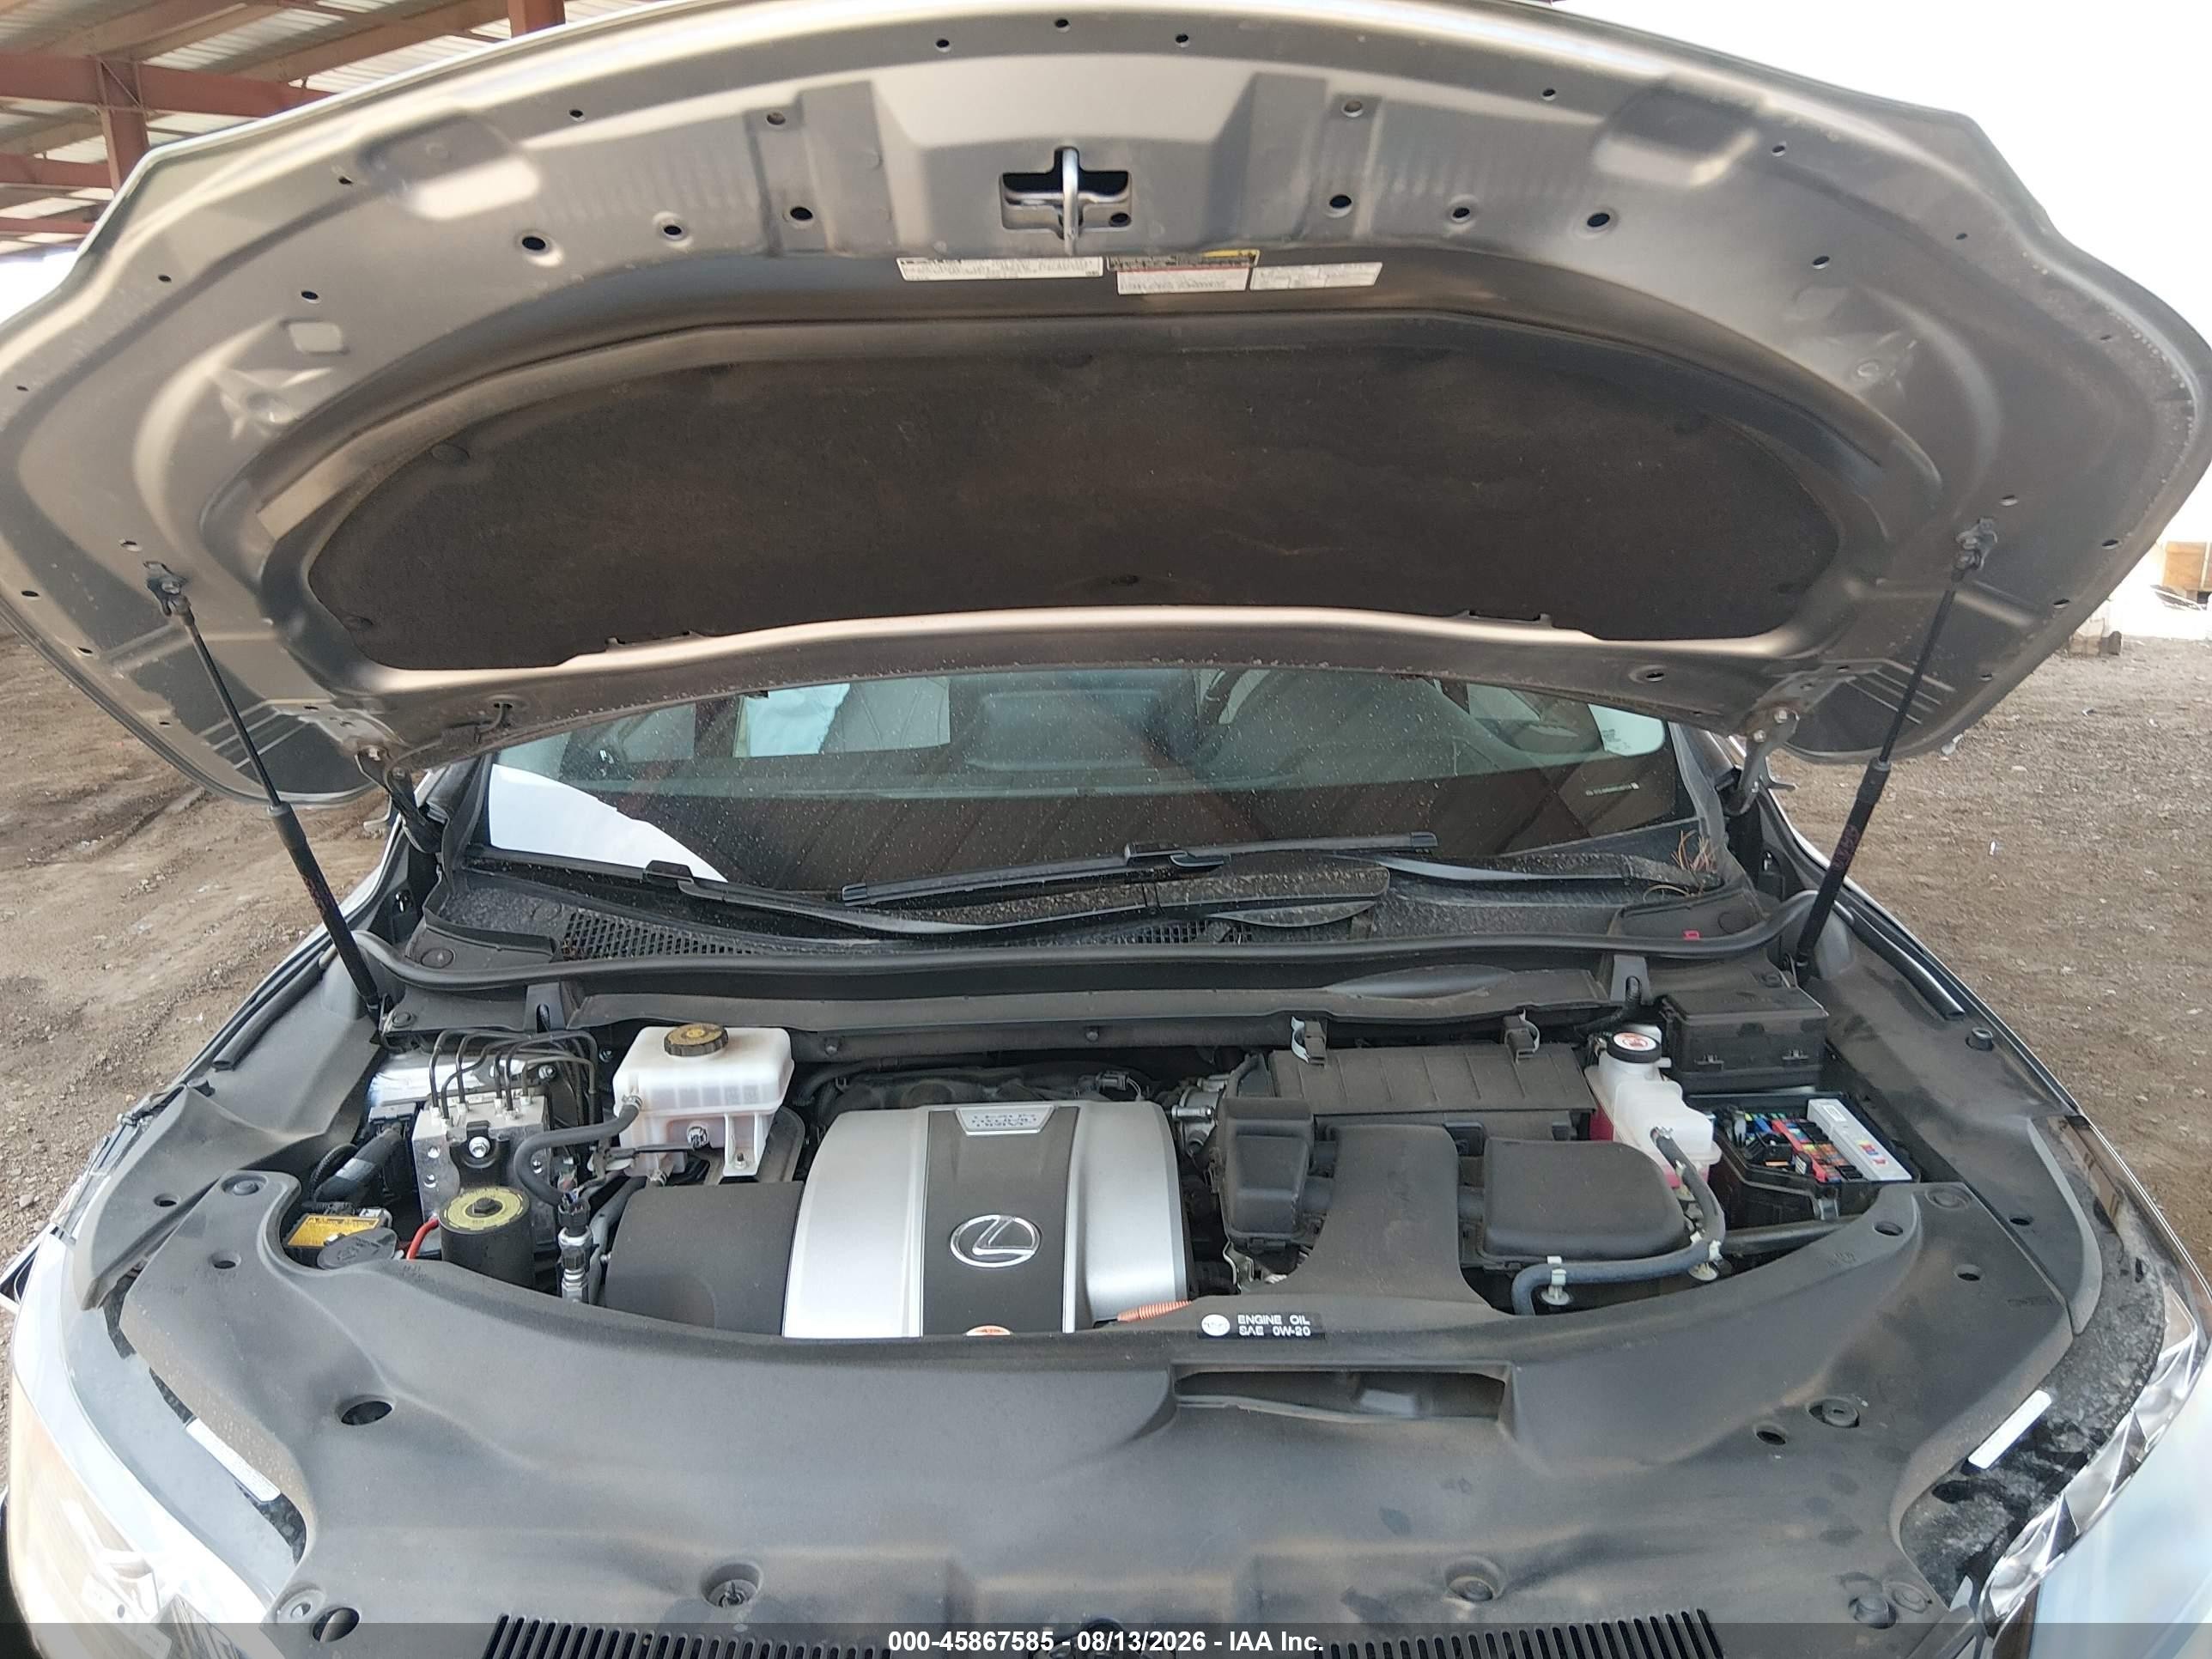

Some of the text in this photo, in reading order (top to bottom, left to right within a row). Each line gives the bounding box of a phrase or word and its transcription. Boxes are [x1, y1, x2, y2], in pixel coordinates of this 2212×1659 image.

[1237, 1314, 1283, 1325] ENGINE
[1289, 1314, 1311, 1326] OIL
[1238, 1326, 1311, 1336] SAE 0W-20
